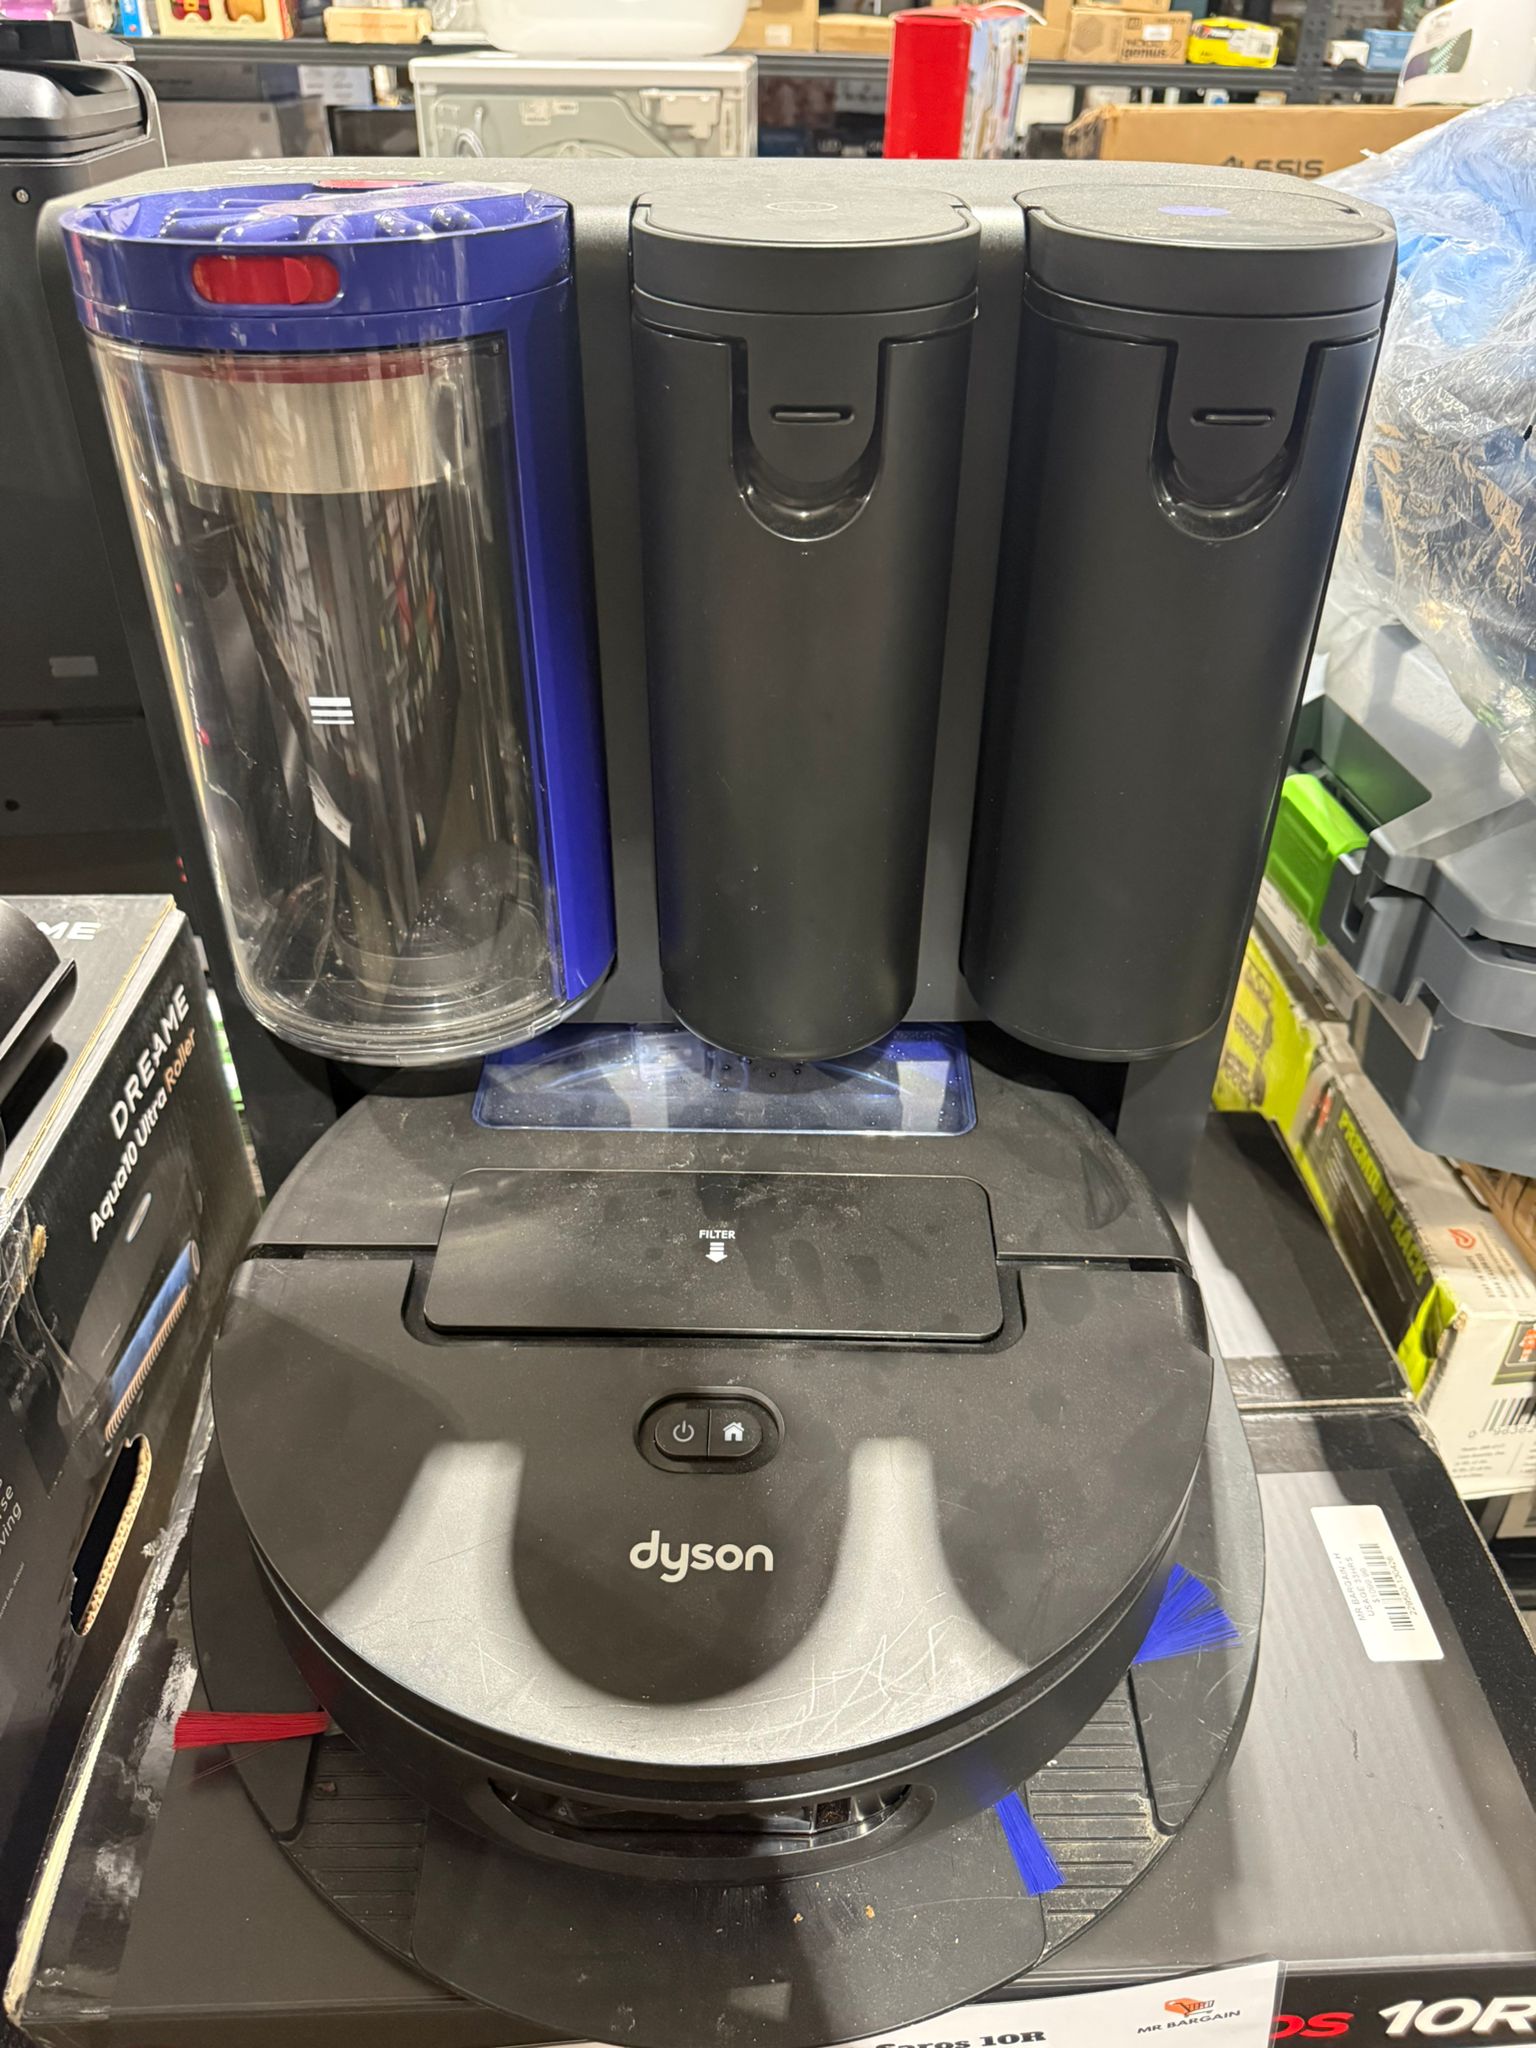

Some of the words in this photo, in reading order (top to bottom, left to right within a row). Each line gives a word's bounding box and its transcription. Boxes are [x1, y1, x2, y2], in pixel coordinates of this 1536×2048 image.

[109, 984, 190, 1140] DREAME
[89, 1141, 139, 1243] Aqua10
[134, 1087, 168, 1147] Ultra
[162, 1027, 196, 1093] Roller
[699, 1230, 736, 1239] FILTER
[1390, 1213, 1429, 1286] RACK
[629, 1530, 774, 1583] dyson
[1338, 1566, 1361, 1605] BARGAIN
[1357, 1586, 1375, 1616] USAGE
[1353, 1606, 1366, 1620] MR
[1137, 2024, 1163, 2034] MR
[1167, 2010, 1241, 2029] BARGAIN
[1378, 1997, 1536, 2039] 10R
[980, 2031, 1047, 2047] 10R
